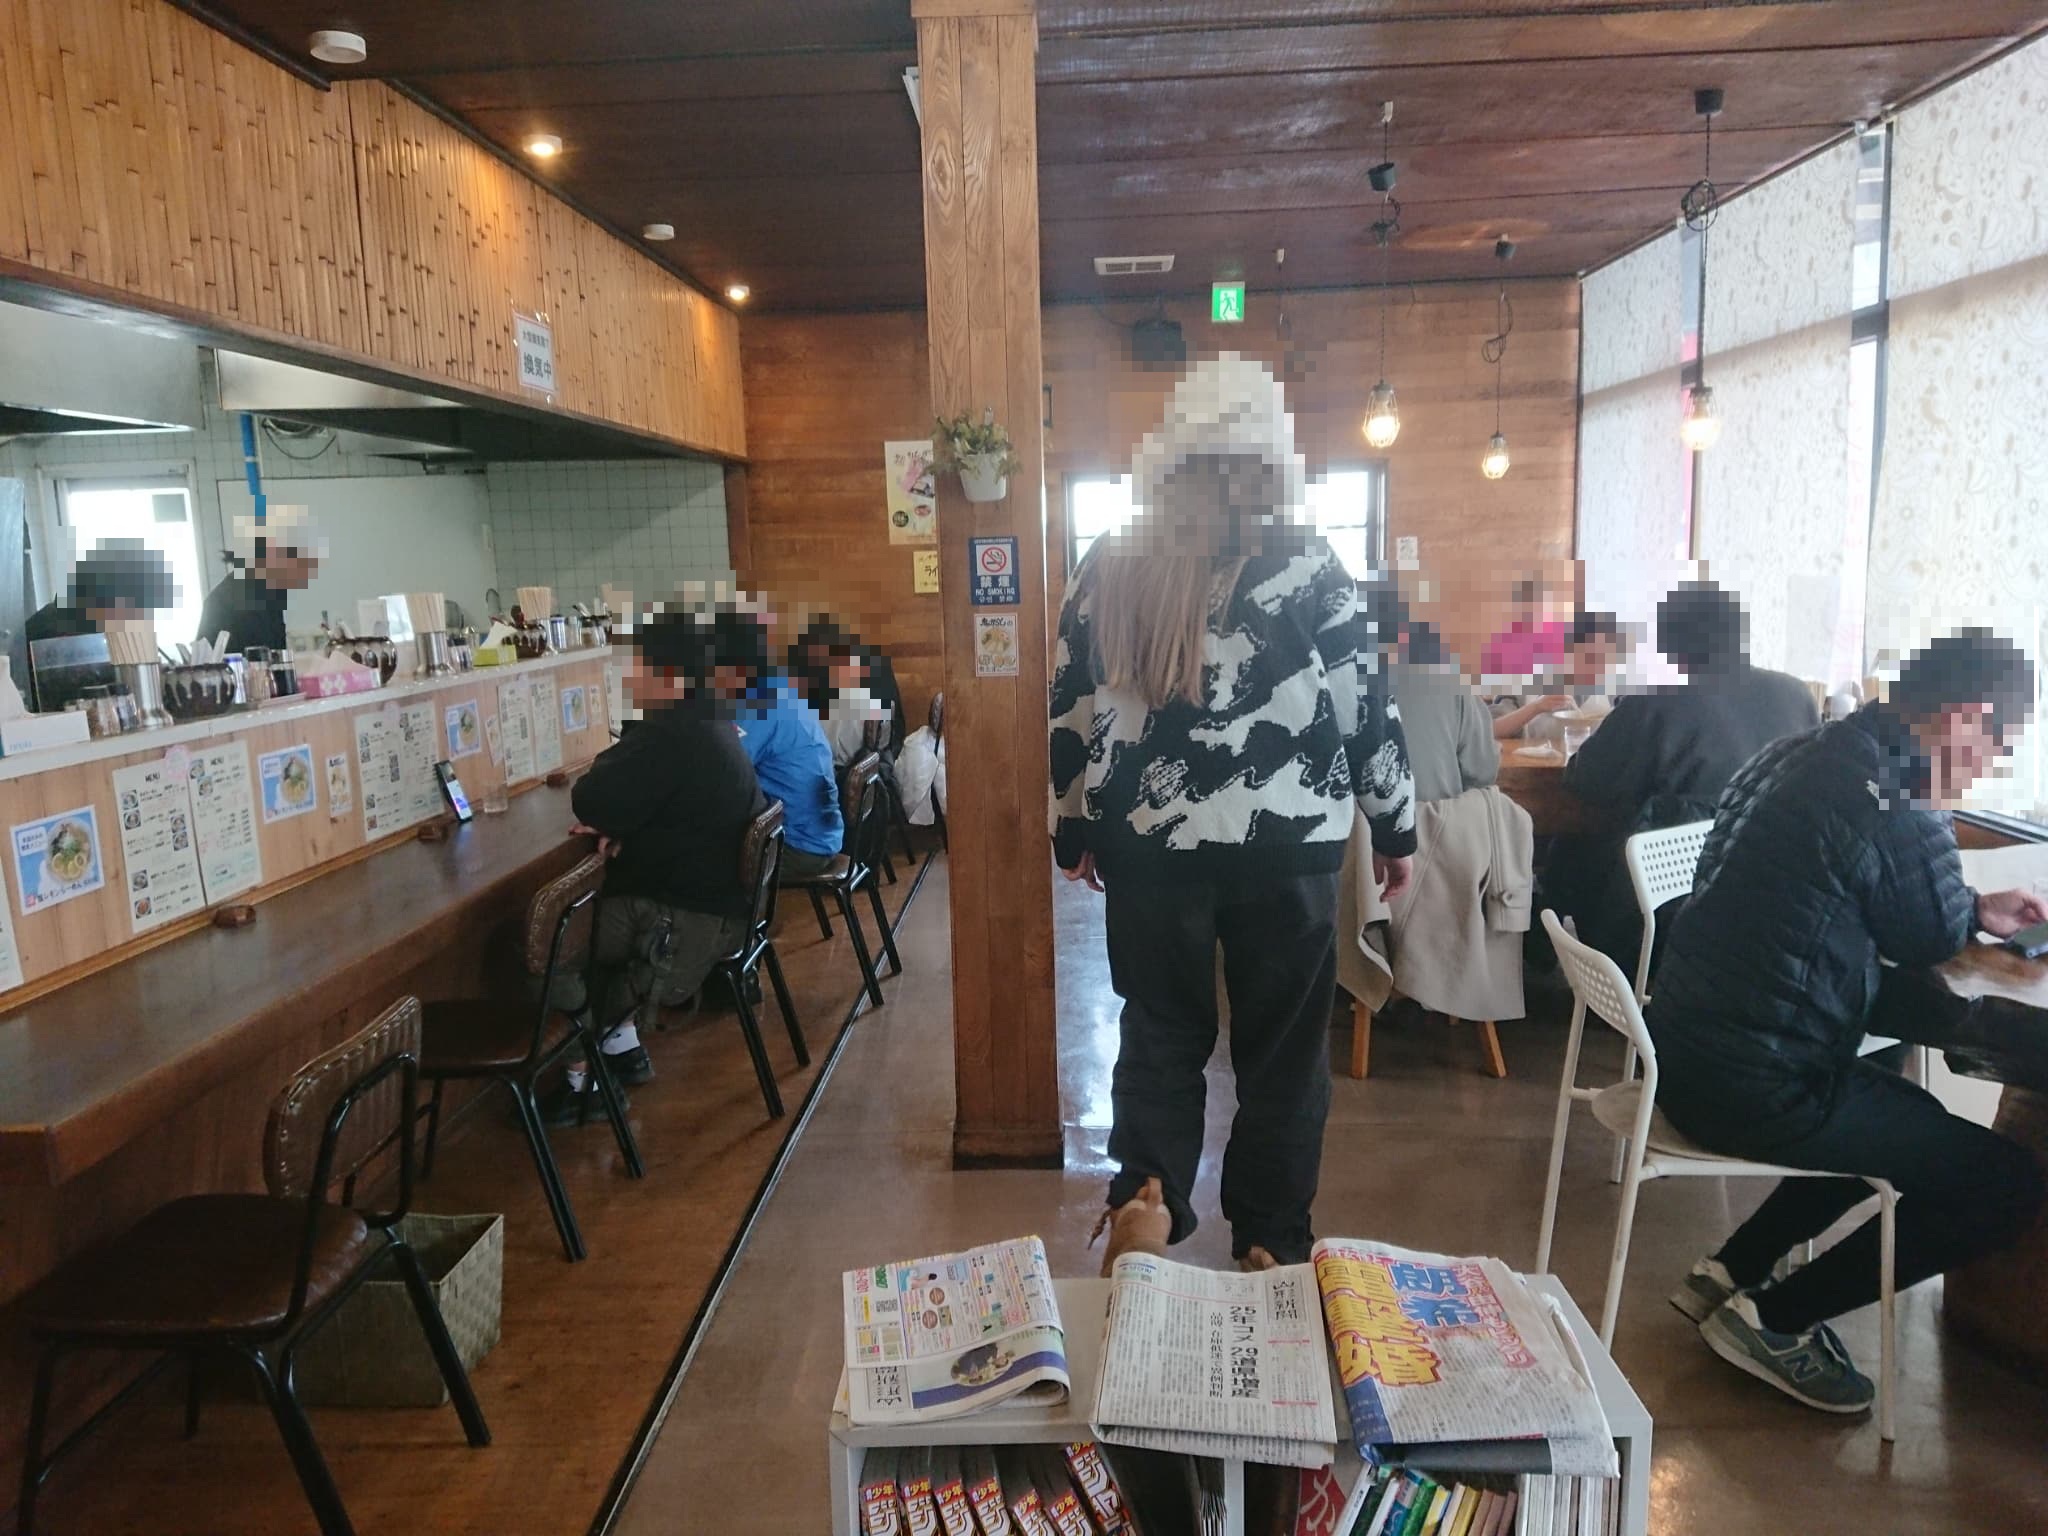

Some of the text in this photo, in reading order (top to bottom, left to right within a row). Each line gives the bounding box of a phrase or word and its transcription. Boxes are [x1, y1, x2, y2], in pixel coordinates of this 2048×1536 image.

[524, 352, 551, 380] 換気中
[980, 576, 1010, 587] 禁煙
[987, 587, 1016, 595] SMOKING
[145, 772, 160, 782] MENU
